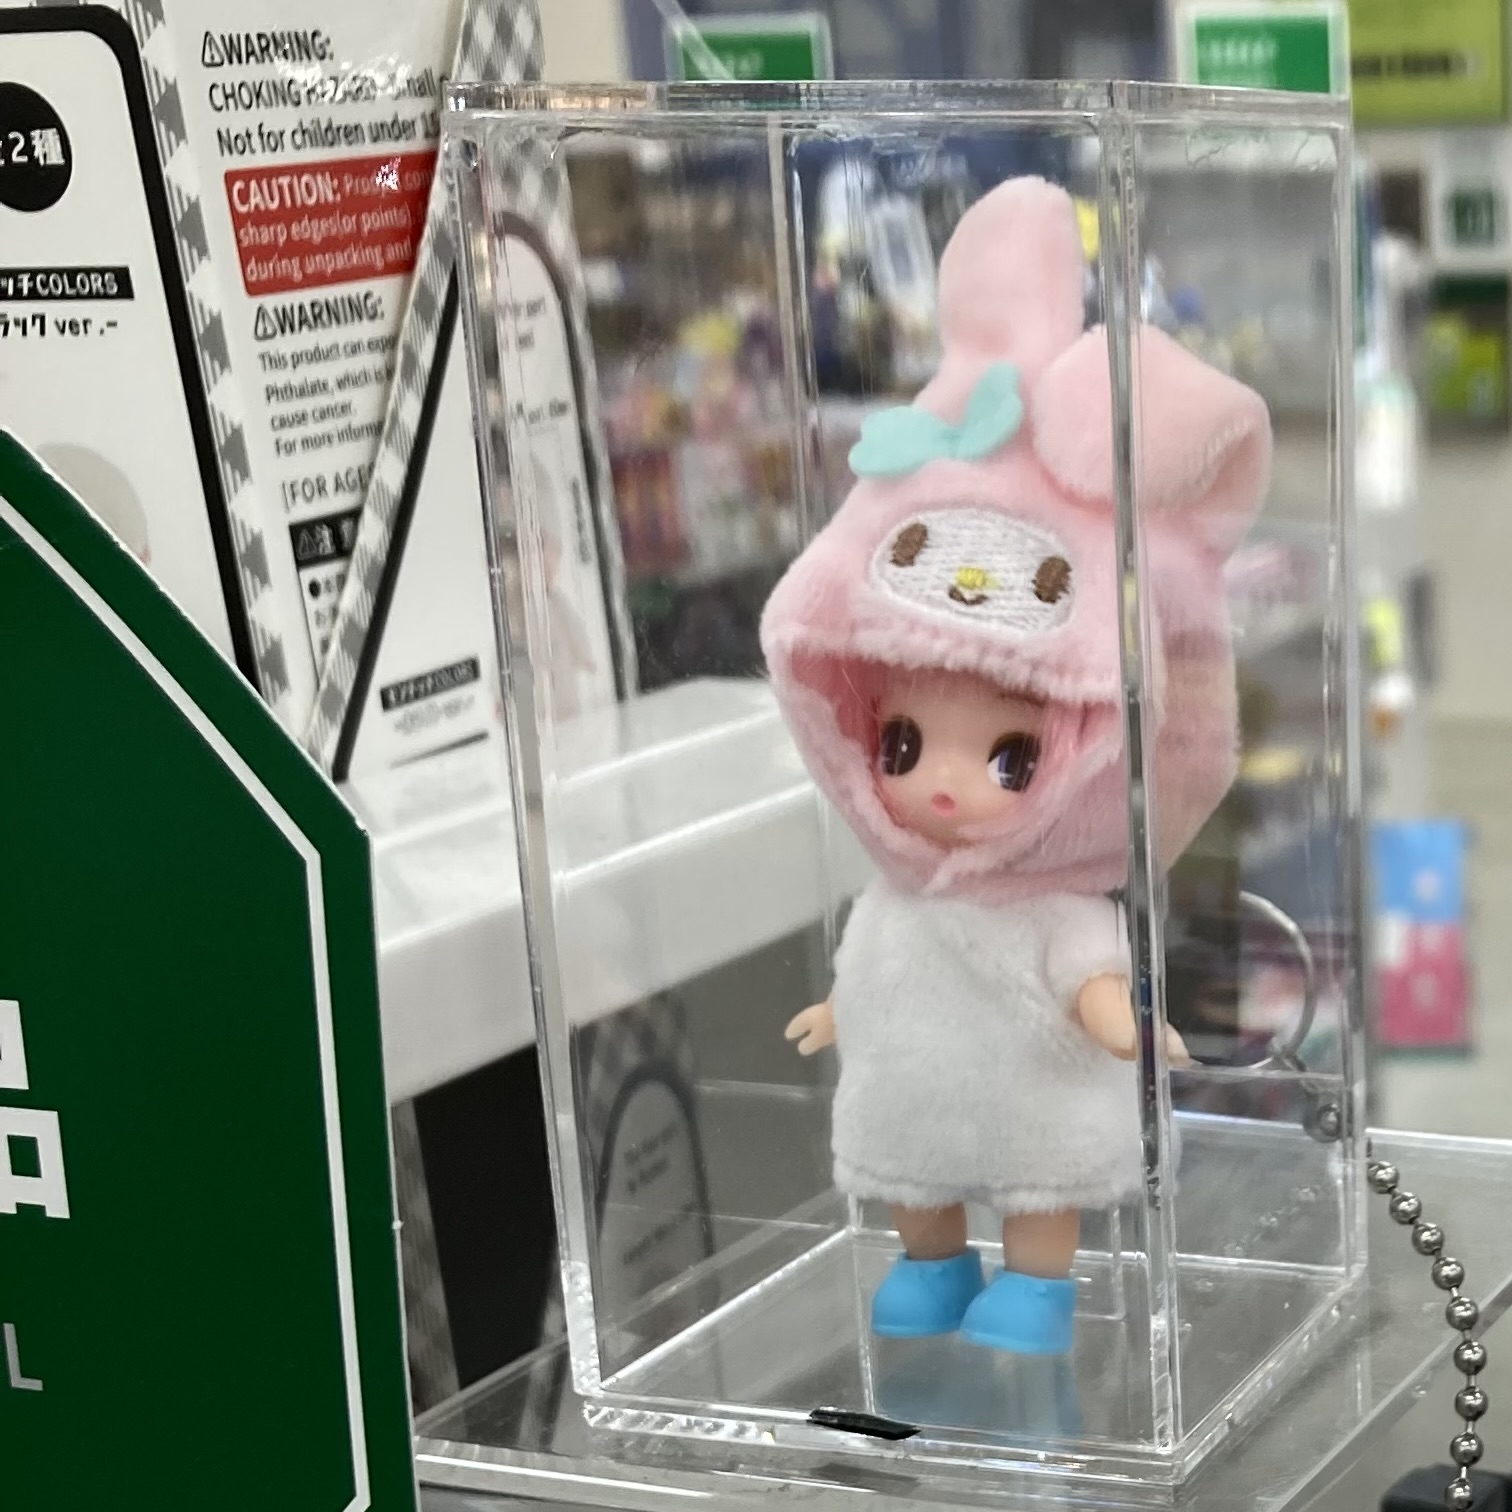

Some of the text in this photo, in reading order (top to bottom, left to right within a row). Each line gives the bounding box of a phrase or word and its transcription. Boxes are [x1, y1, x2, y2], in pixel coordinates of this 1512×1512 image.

[221, 29, 334, 65] WARNING:
[209, 78, 301, 112] CHOKING
[0, 128, 65, 166] 2種
[217, 127, 255, 157] Not
[258, 122, 285, 153] for
[291, 116, 365, 150] children
[369, 112, 417, 142] under
[233, 172, 341, 213] CAUTION:
[239, 219, 287, 248] sharp
[247, 236, 411, 283] during unpacking and
[274, 291, 384, 336] WARNING:
[258, 349, 288, 372] This
[291, 340, 339, 374] product
[343, 339, 365, 355] can
[336, 364, 371, 391] which
[271, 408, 308, 431] cause
[274, 435, 297, 457] For
[301, 430, 334, 451] more
